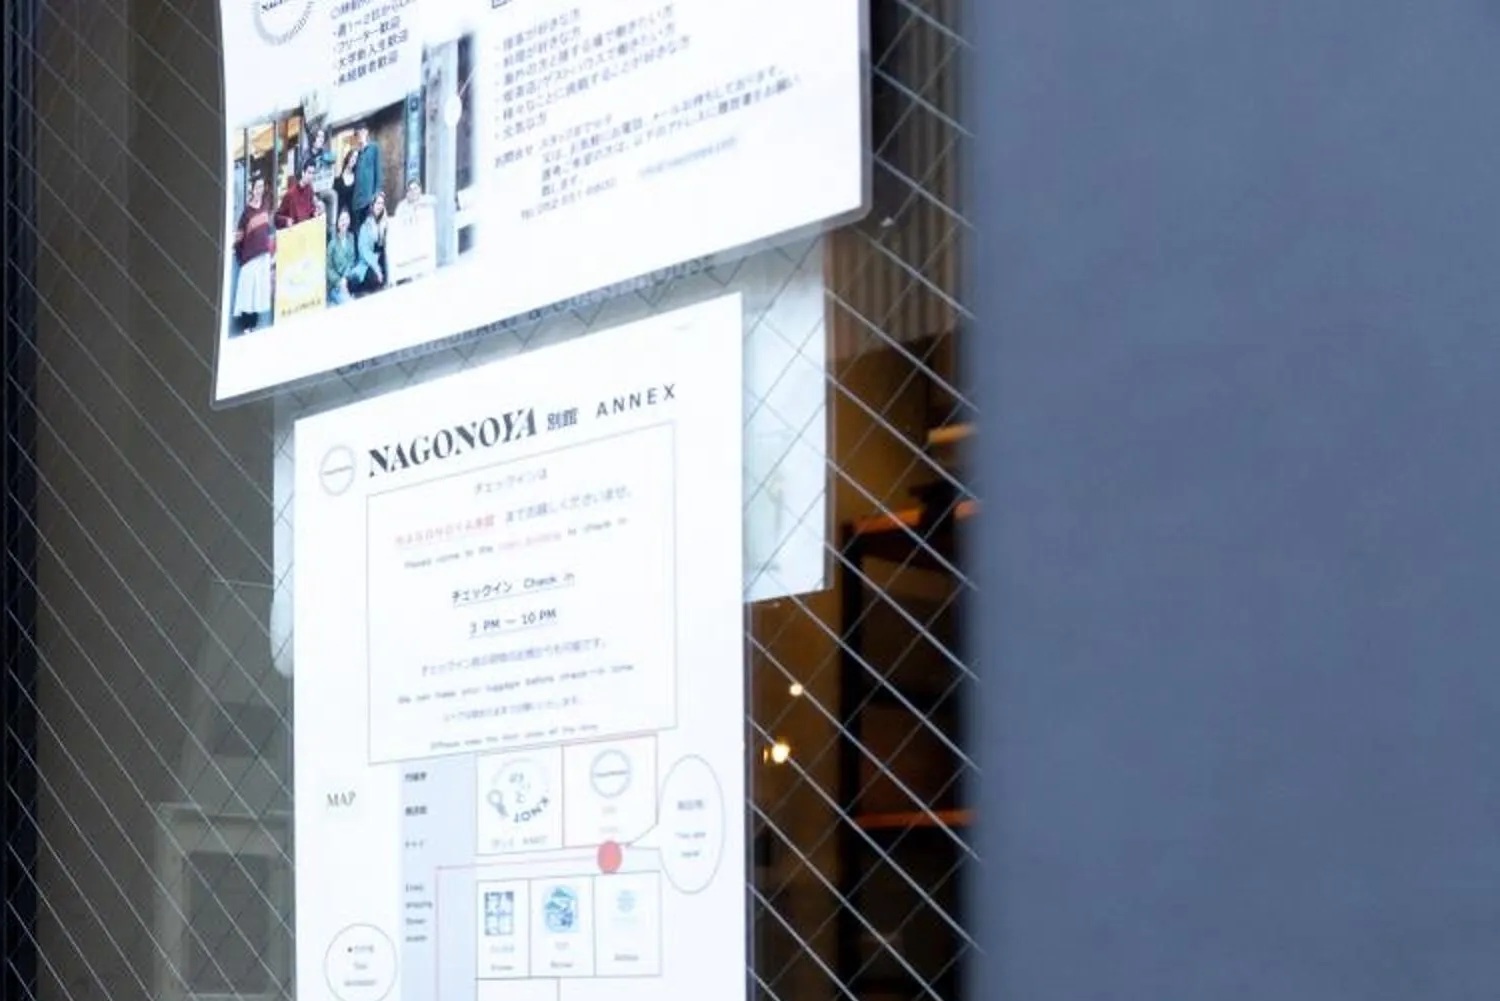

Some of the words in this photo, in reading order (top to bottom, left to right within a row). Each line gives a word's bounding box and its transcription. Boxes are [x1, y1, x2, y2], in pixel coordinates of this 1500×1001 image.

[369, 408, 537, 477] NAGONOYA
[596, 383, 675, 418] ANNEX
[451, 581, 512, 604] チェックイン
[523, 575, 557, 590] Check
[483, 618, 500, 632] PM
[521, 611, 537, 626] 10
[539, 607, 557, 622] PM
[325, 791, 357, 808] MAP
